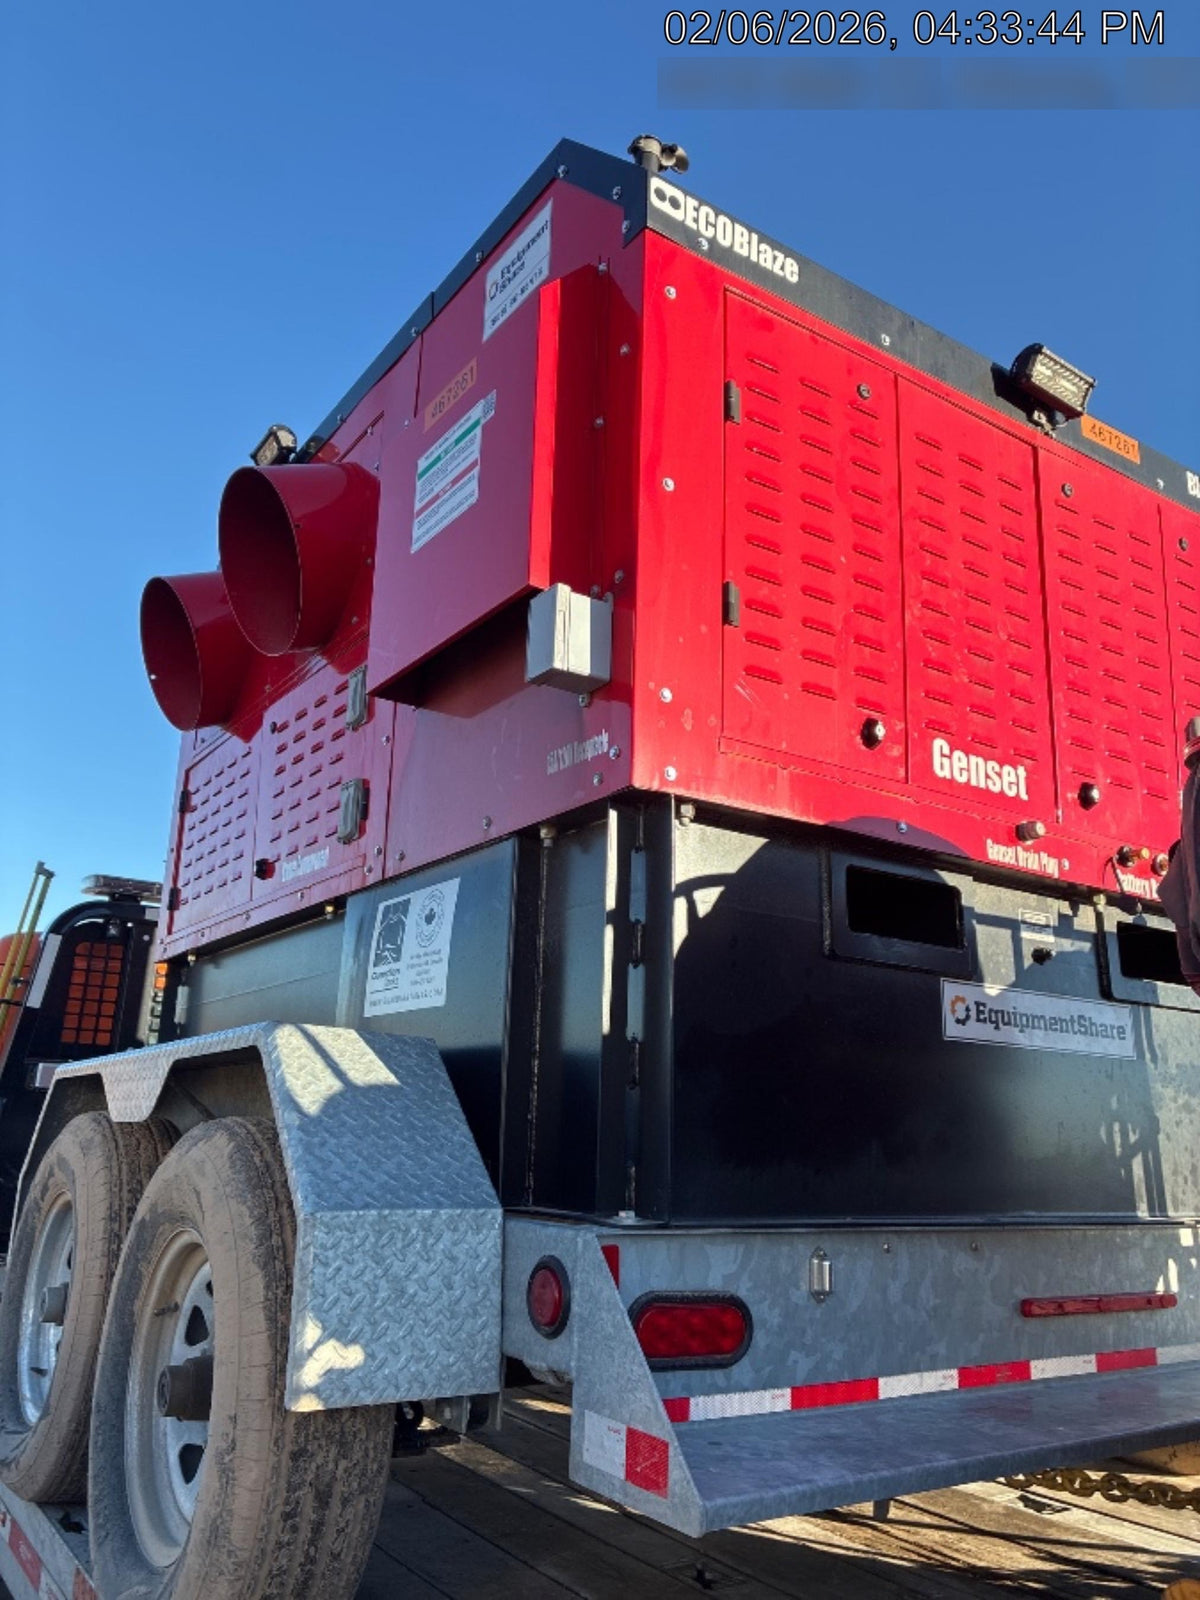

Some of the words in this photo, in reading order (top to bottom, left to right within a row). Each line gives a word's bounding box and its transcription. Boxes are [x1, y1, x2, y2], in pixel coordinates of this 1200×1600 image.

[684, 194, 799, 283] ECOBlaze
[1089, 423, 1136, 456] 467261
[932, 737, 1029, 801] Genset
[986, 838, 1017, 865] Genset
[974, 1001, 1127, 1040] EquipmentShare
